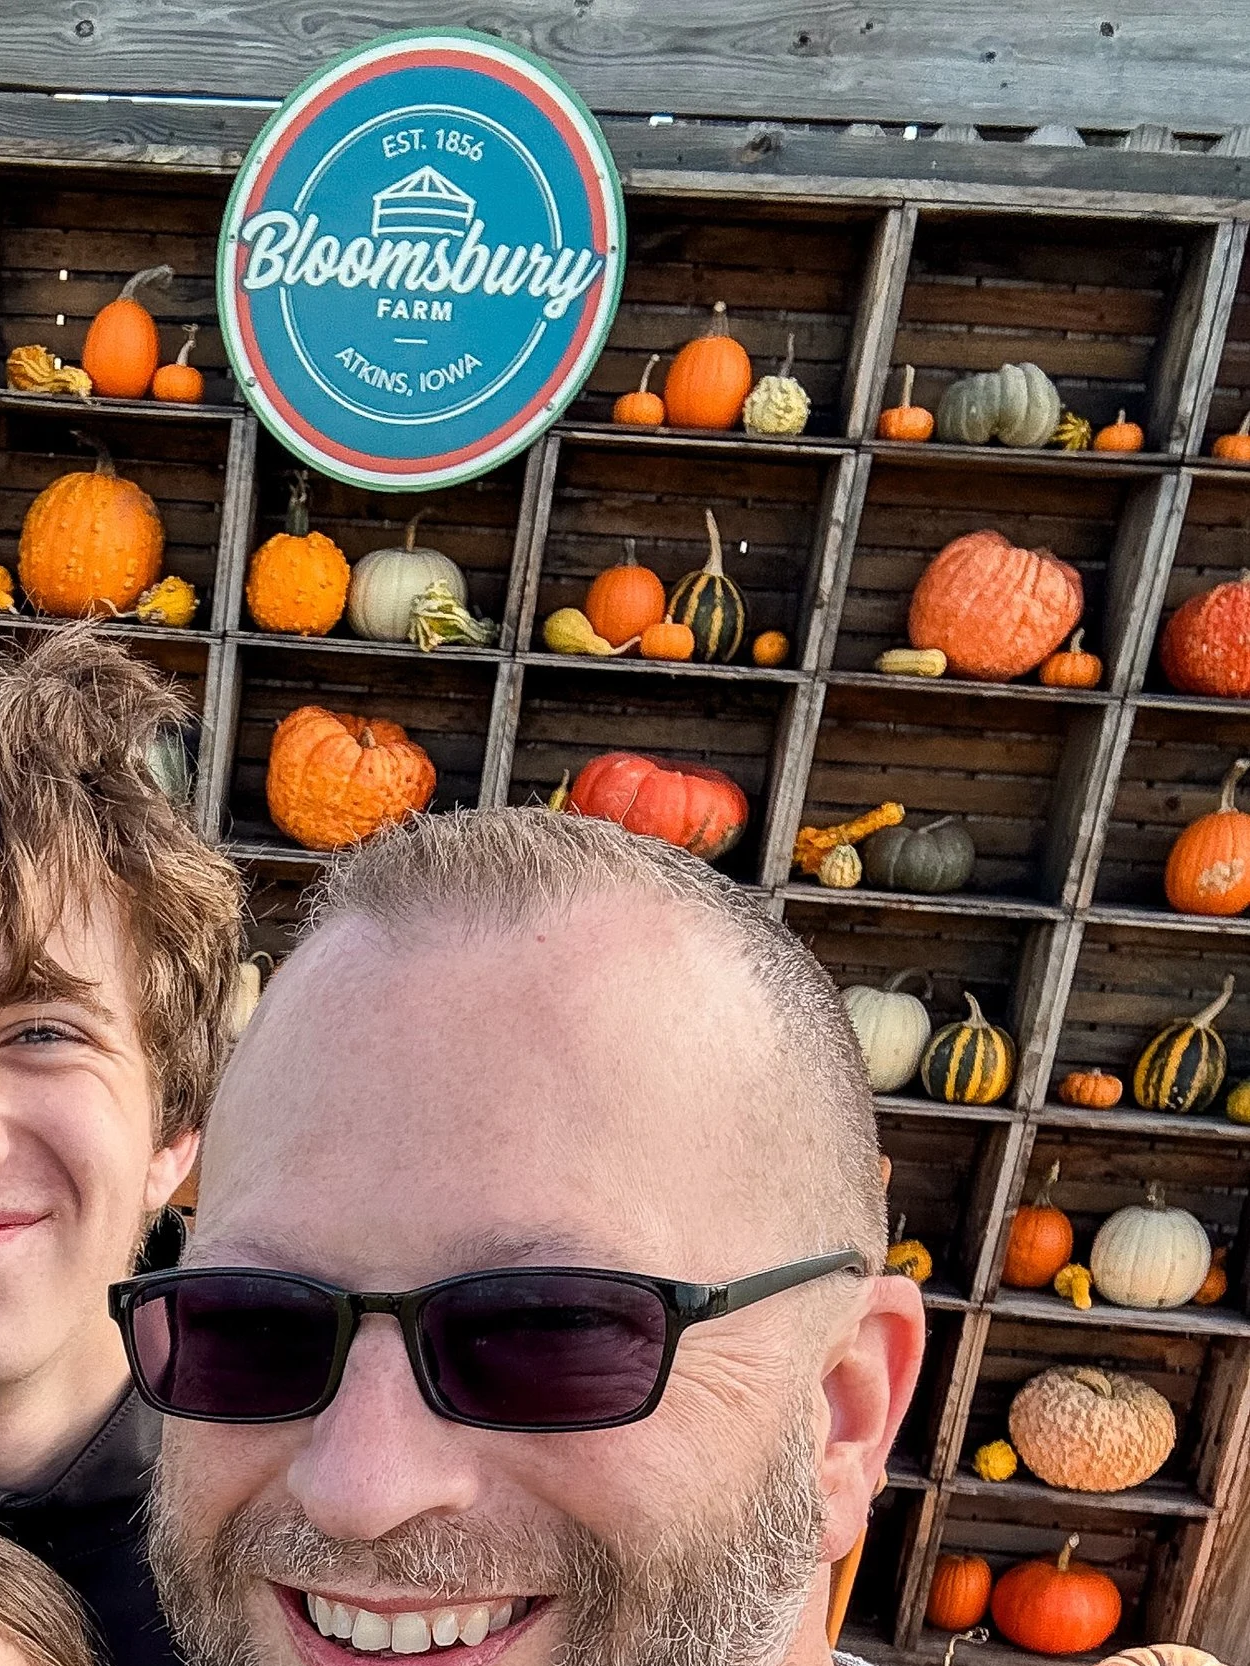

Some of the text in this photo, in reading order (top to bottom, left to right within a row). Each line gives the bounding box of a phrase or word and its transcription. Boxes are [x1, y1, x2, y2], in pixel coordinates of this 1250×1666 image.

[381, 127, 485, 162] EST. 1856
[241, 208, 603, 320] Bloomsbury
[376, 297, 454, 322] FARM
[334, 346, 483, 397] ATKINS, IOWA
